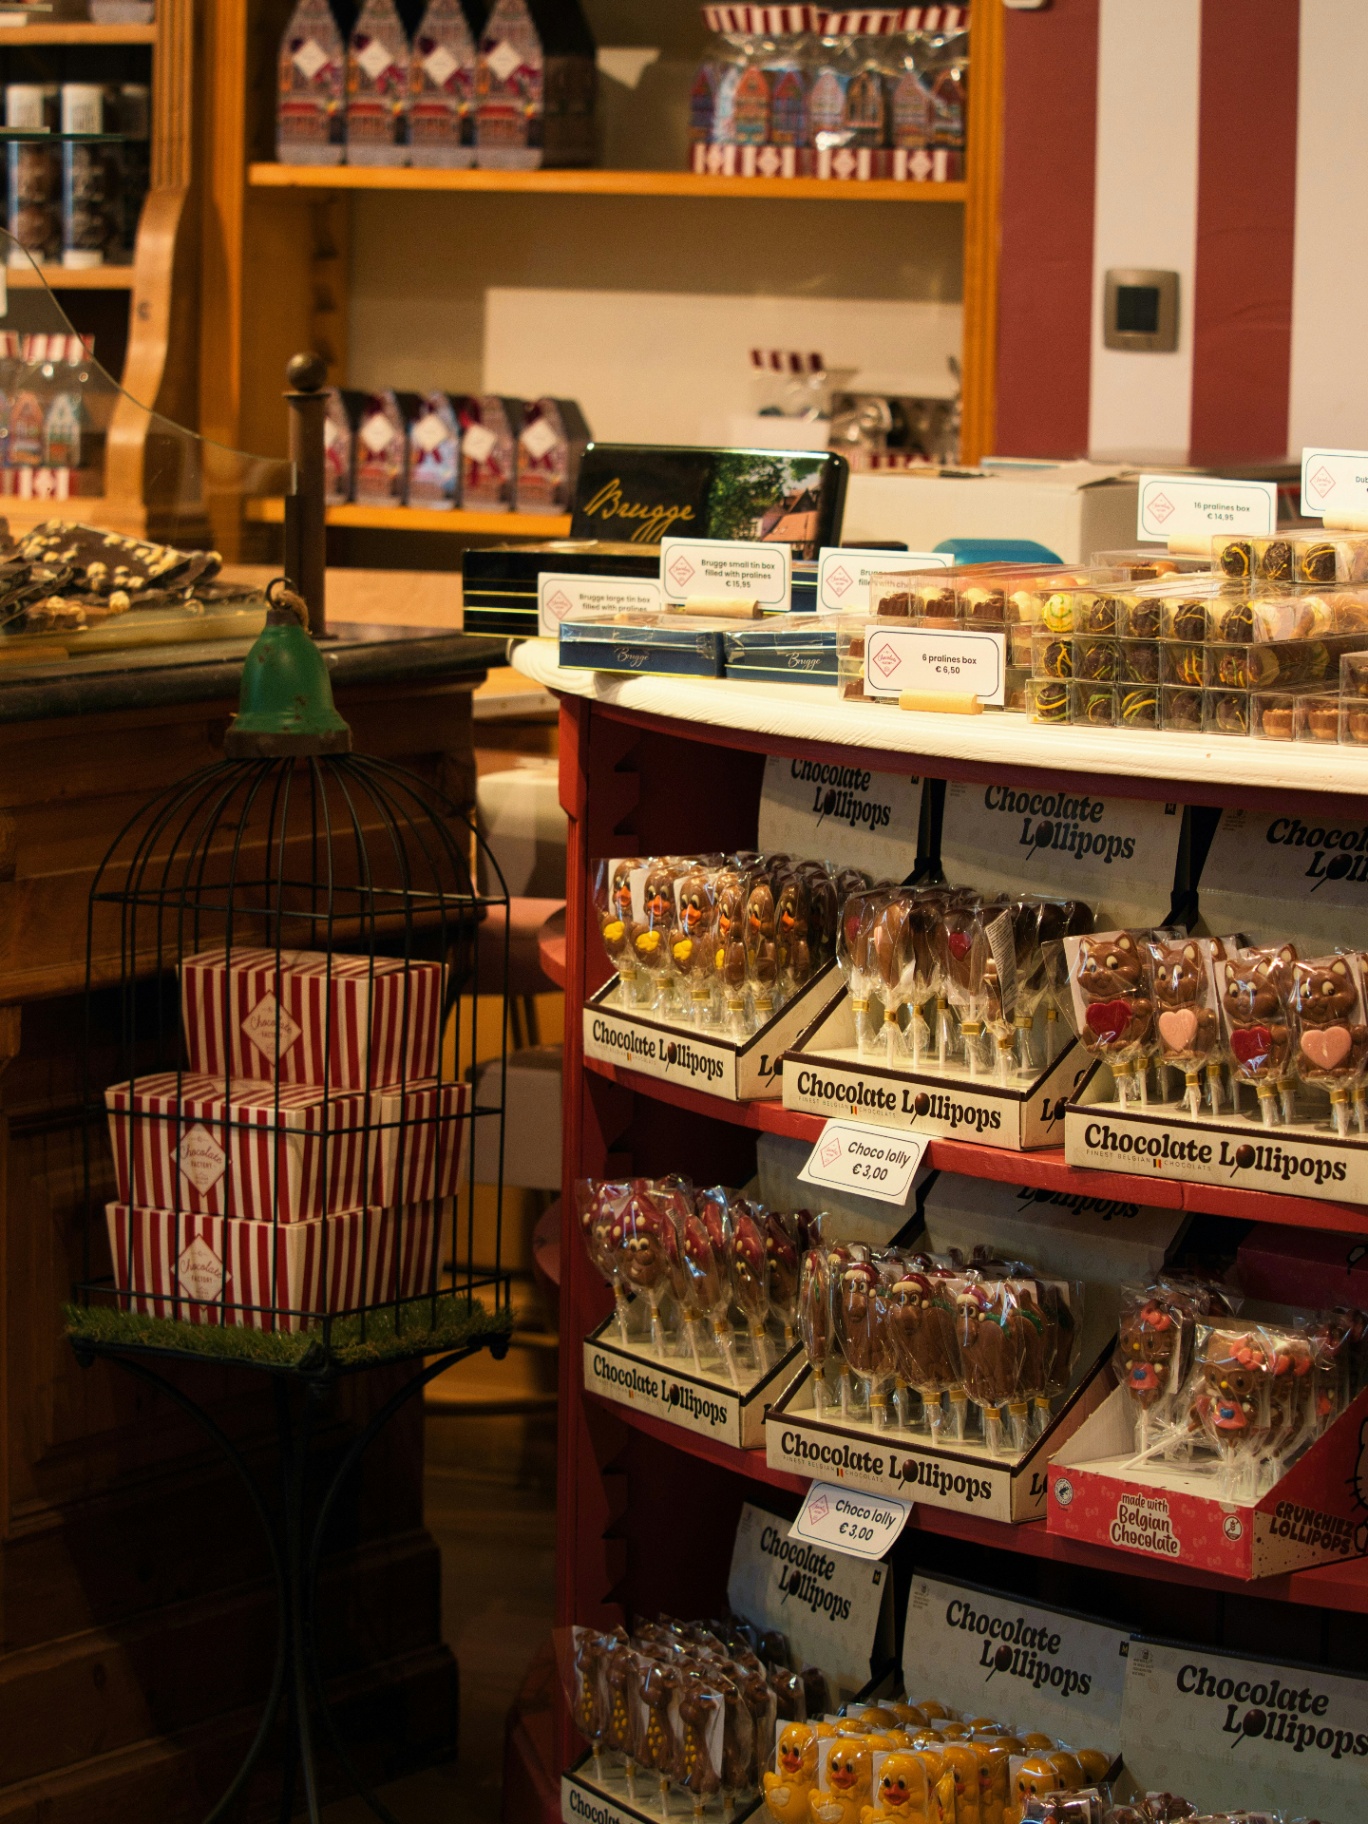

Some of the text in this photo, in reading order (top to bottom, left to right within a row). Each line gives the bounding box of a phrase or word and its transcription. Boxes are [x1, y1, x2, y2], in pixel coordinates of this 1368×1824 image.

[583, 478, 696, 542] Brugge
[1194, 501, 1250, 512] 16 pralines box
[701, 559, 775, 570] Brugge small tin box
[705, 569, 771, 581] filled with pralines
[579, 593, 605, 604] Brugge
[606, 594, 625, 604] large
[637, 595, 650, 603] box
[732, 580, 751, 589] 15,95
[582, 602, 647, 612] filled with pralines
[614, 646, 649, 667] Brugge
[785, 652, 822, 670] Brugge
[922, 653, 977, 665] 6 pralines box
[935, 665, 960, 675] € 6,50
[791, 758, 871, 792] Chocolate
[812, 786, 891, 831] Lollipops
[984, 784, 1104, 823] Chocolate
[1019, 817, 1136, 864] Lollipops
[1266, 817, 1368, 853] Chocol
[592, 1019, 656, 1058] Chocolate
[658, 1038, 724, 1081] Lollipops
[797, 1070, 897, 1111] Chocolate
[901, 1088, 1001, 1133] Lollipops
[847, 1141, 884, 1160] Choco
[885, 1146, 911, 1169] lolly
[1084, 1123, 1347, 1185] Chocolate Lollipops
[1086, 1149, 1113, 1158] FINEST
[1117, 1154, 1151, 1163] BELGIAN
[852, 1163, 888, 1181] € 3,00
[593, 1354, 658, 1397] Chocolate
[661, 1379, 727, 1426] Lollipops
[781, 1431, 883, 1476] Chocolate
[888, 1455, 992, 1502] Lollipops
[835, 1499, 871, 1520] Choco
[871, 1508, 896, 1531] lolly
[1118, 1505, 1170, 1533] Belgian
[1122, 1493, 1168, 1513] made with
[839, 1522, 874, 1541] € 3,00
[1111, 1524, 1178, 1554] Chocolate
[1269, 1516, 1351, 1555] LOLLIPOPS
[760, 1526, 836, 1581] Chocolate
[778, 1564, 852, 1622] Lollipops
[945, 1599, 1062, 1655] Chocolate
[979, 1639, 1092, 1697] Lollipops
[1176, 1664, 1330, 1717] Chocolate
[1222, 1703, 1368, 1760] Lollipops
